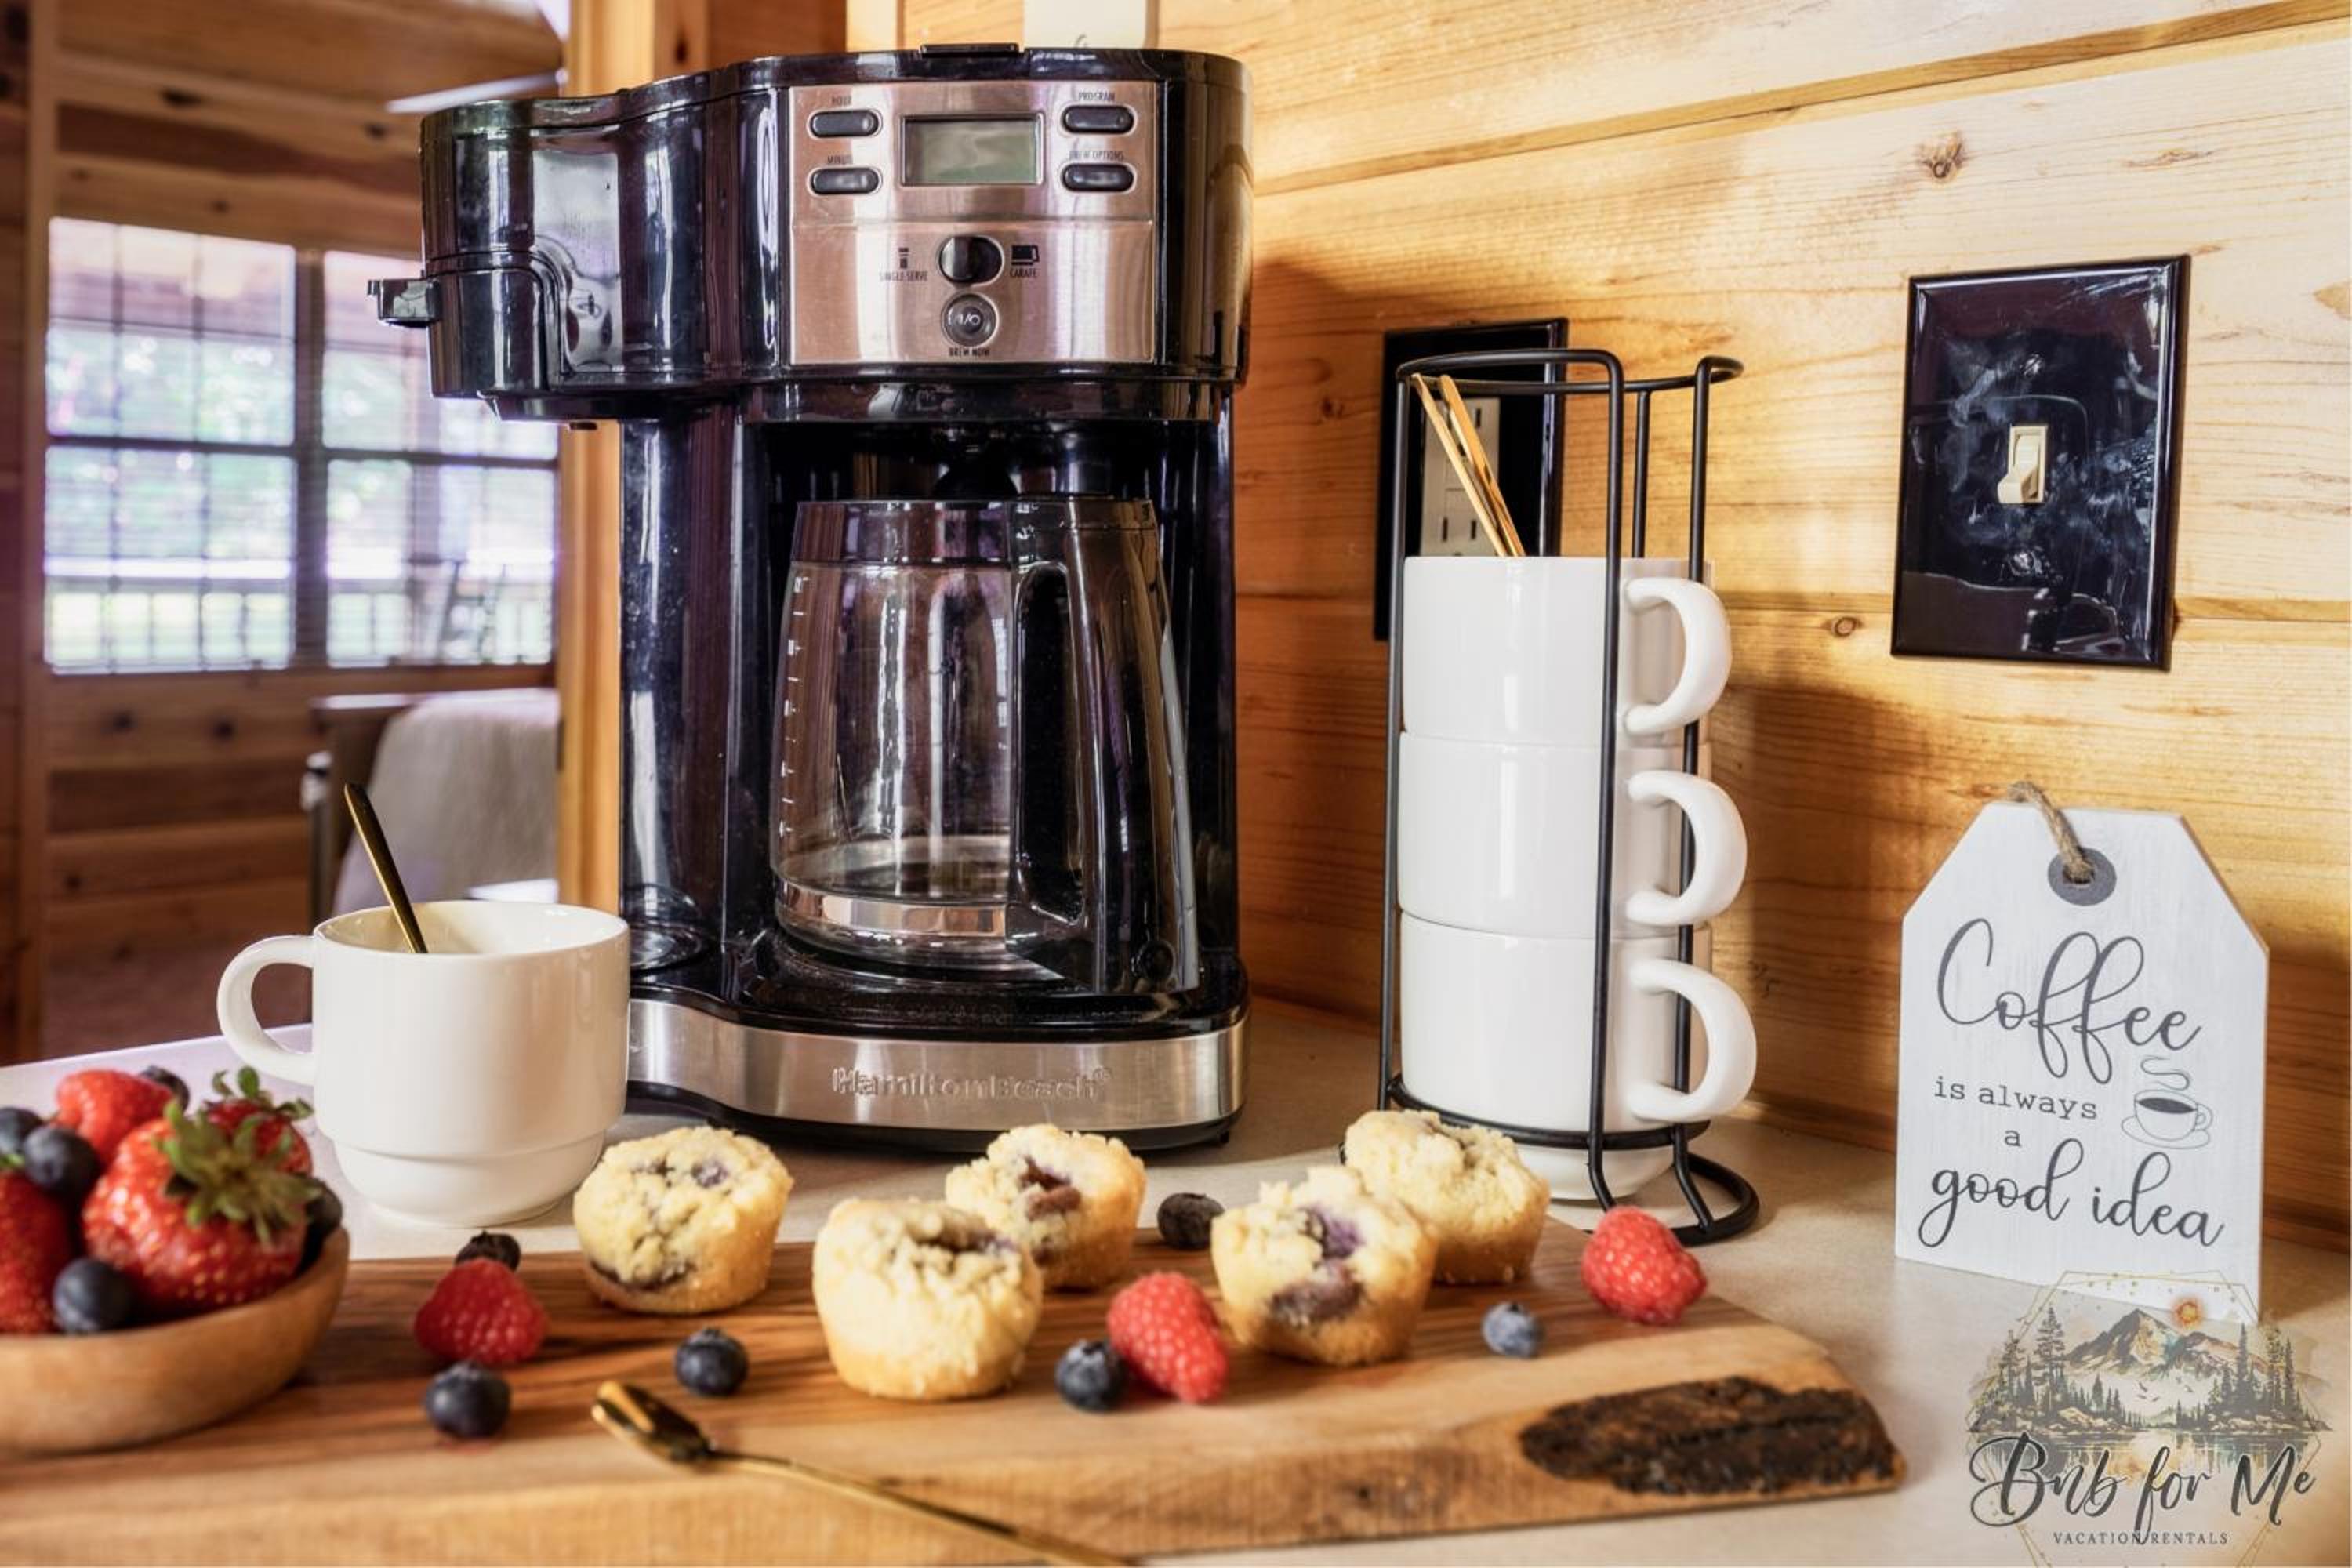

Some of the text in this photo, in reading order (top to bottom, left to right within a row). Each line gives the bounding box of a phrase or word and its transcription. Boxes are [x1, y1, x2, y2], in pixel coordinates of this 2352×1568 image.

[949, 347, 991, 358] BREW NOW
[1937, 917, 2201, 1085] Coffee
[832, 1067, 986, 1095] Hamilton
[1933, 1076, 2098, 1120] is always
[2003, 1129, 2022, 1148] a
[1918, 1138, 2225, 1248] good idea
